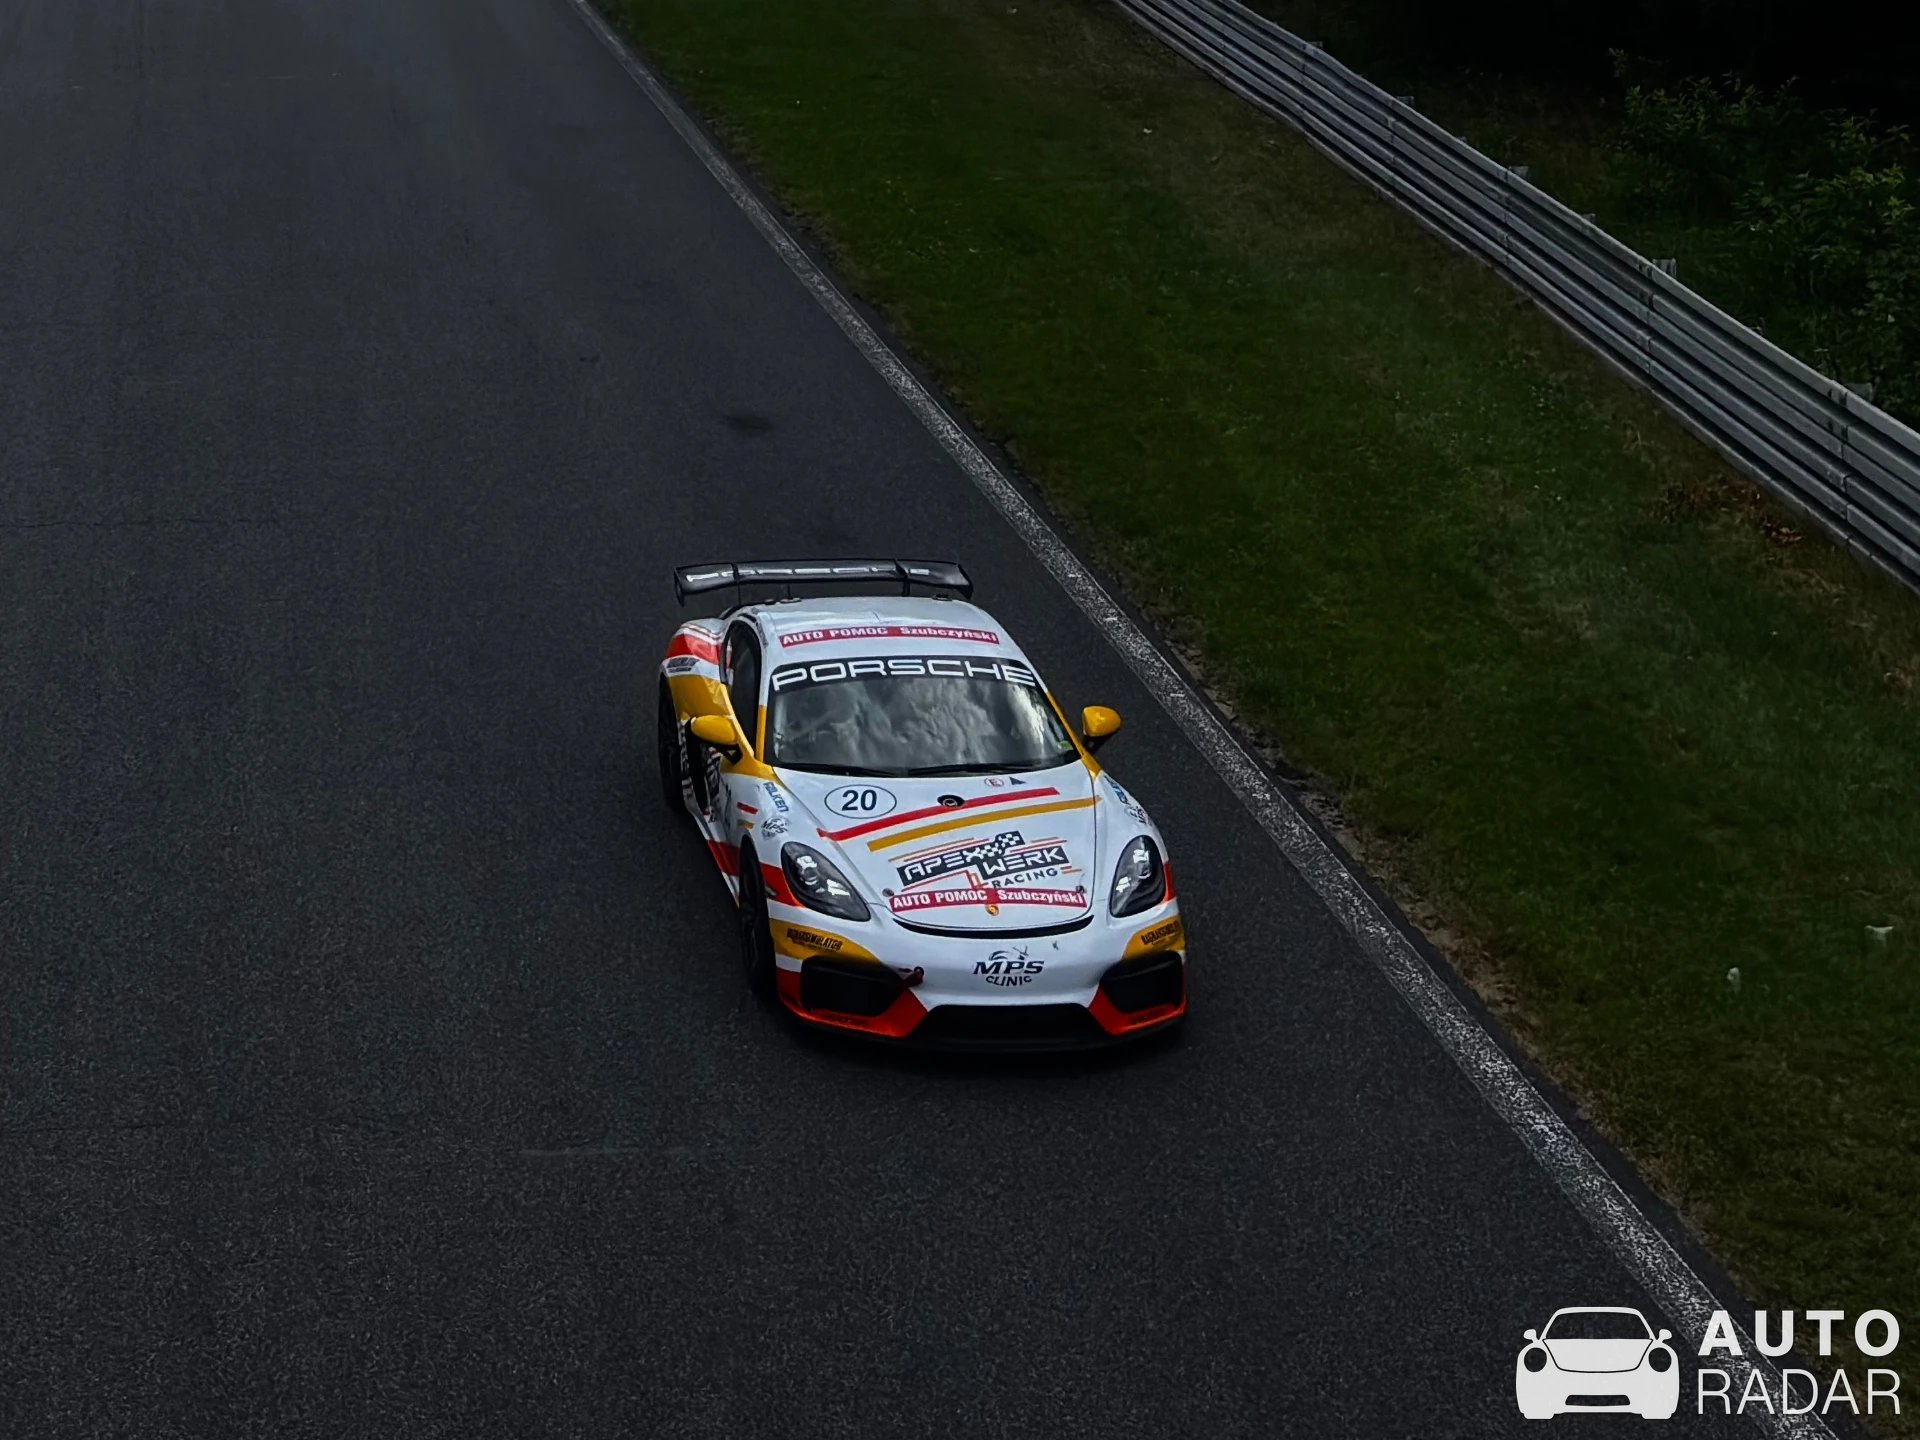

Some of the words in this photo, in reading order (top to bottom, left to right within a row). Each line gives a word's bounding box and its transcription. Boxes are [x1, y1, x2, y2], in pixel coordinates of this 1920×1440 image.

[783, 631, 824, 646] AUTO
[830, 627, 889, 639] POMOC
[771, 659, 1036, 692] PORSCHE
[763, 781, 789, 813] FALKEN
[842, 789, 878, 811] 20
[904, 849, 985, 881] APEX
[984, 847, 1065, 876] WERK
[991, 868, 1058, 888] RACING
[893, 894, 931, 908] AUTO
[935, 889, 988, 903] POMOC
[998, 889, 1084, 905] Szubczyński
[973, 960, 1045, 975] MPS
[985, 975, 1033, 987] CLINIC
